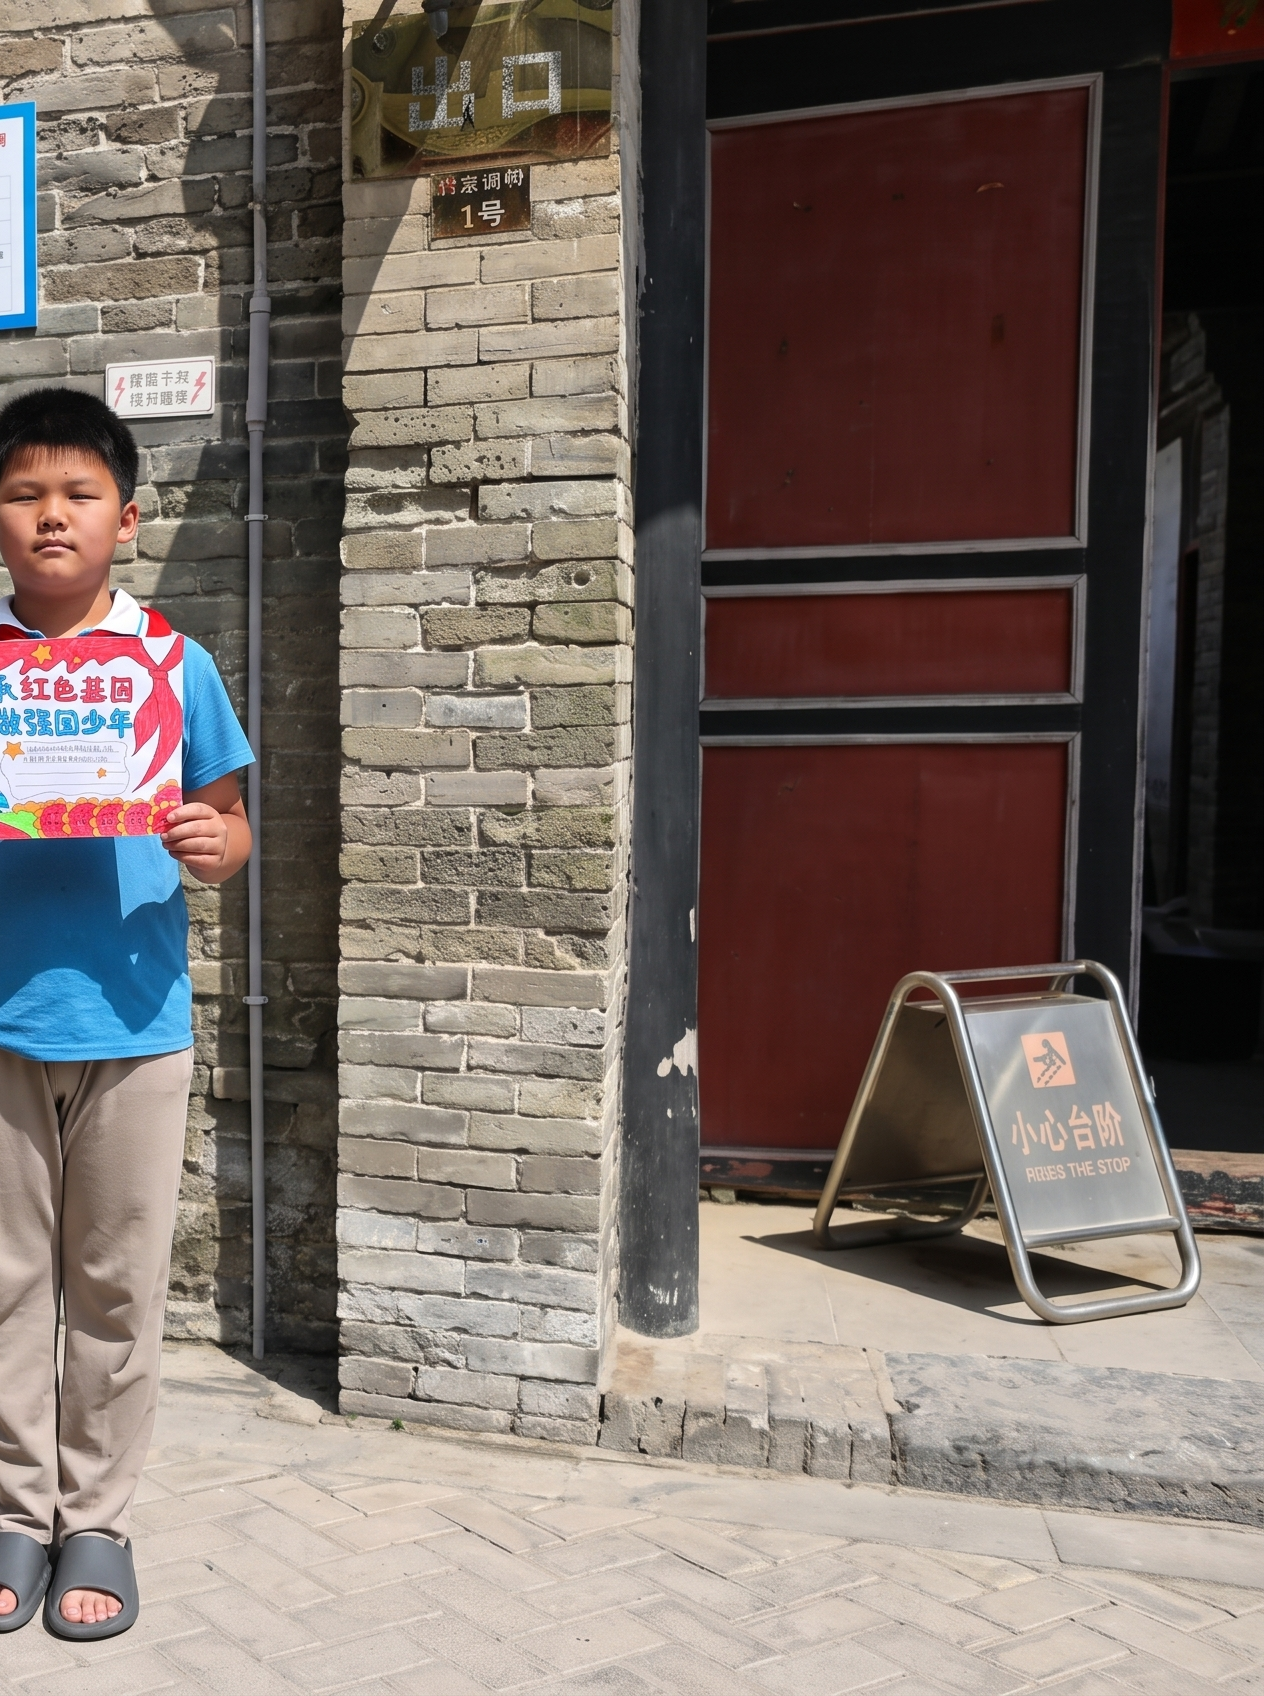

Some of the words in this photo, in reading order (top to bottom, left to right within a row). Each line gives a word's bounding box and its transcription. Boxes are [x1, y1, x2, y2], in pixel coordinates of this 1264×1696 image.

[408, 51, 562, 133] 出口
[460, 199, 505, 229] 1号
[1011, 1101, 1125, 1156] 小心台阶
[1067, 1161, 1096, 1178] THE
[1097, 1157, 1131, 1174] STOP
